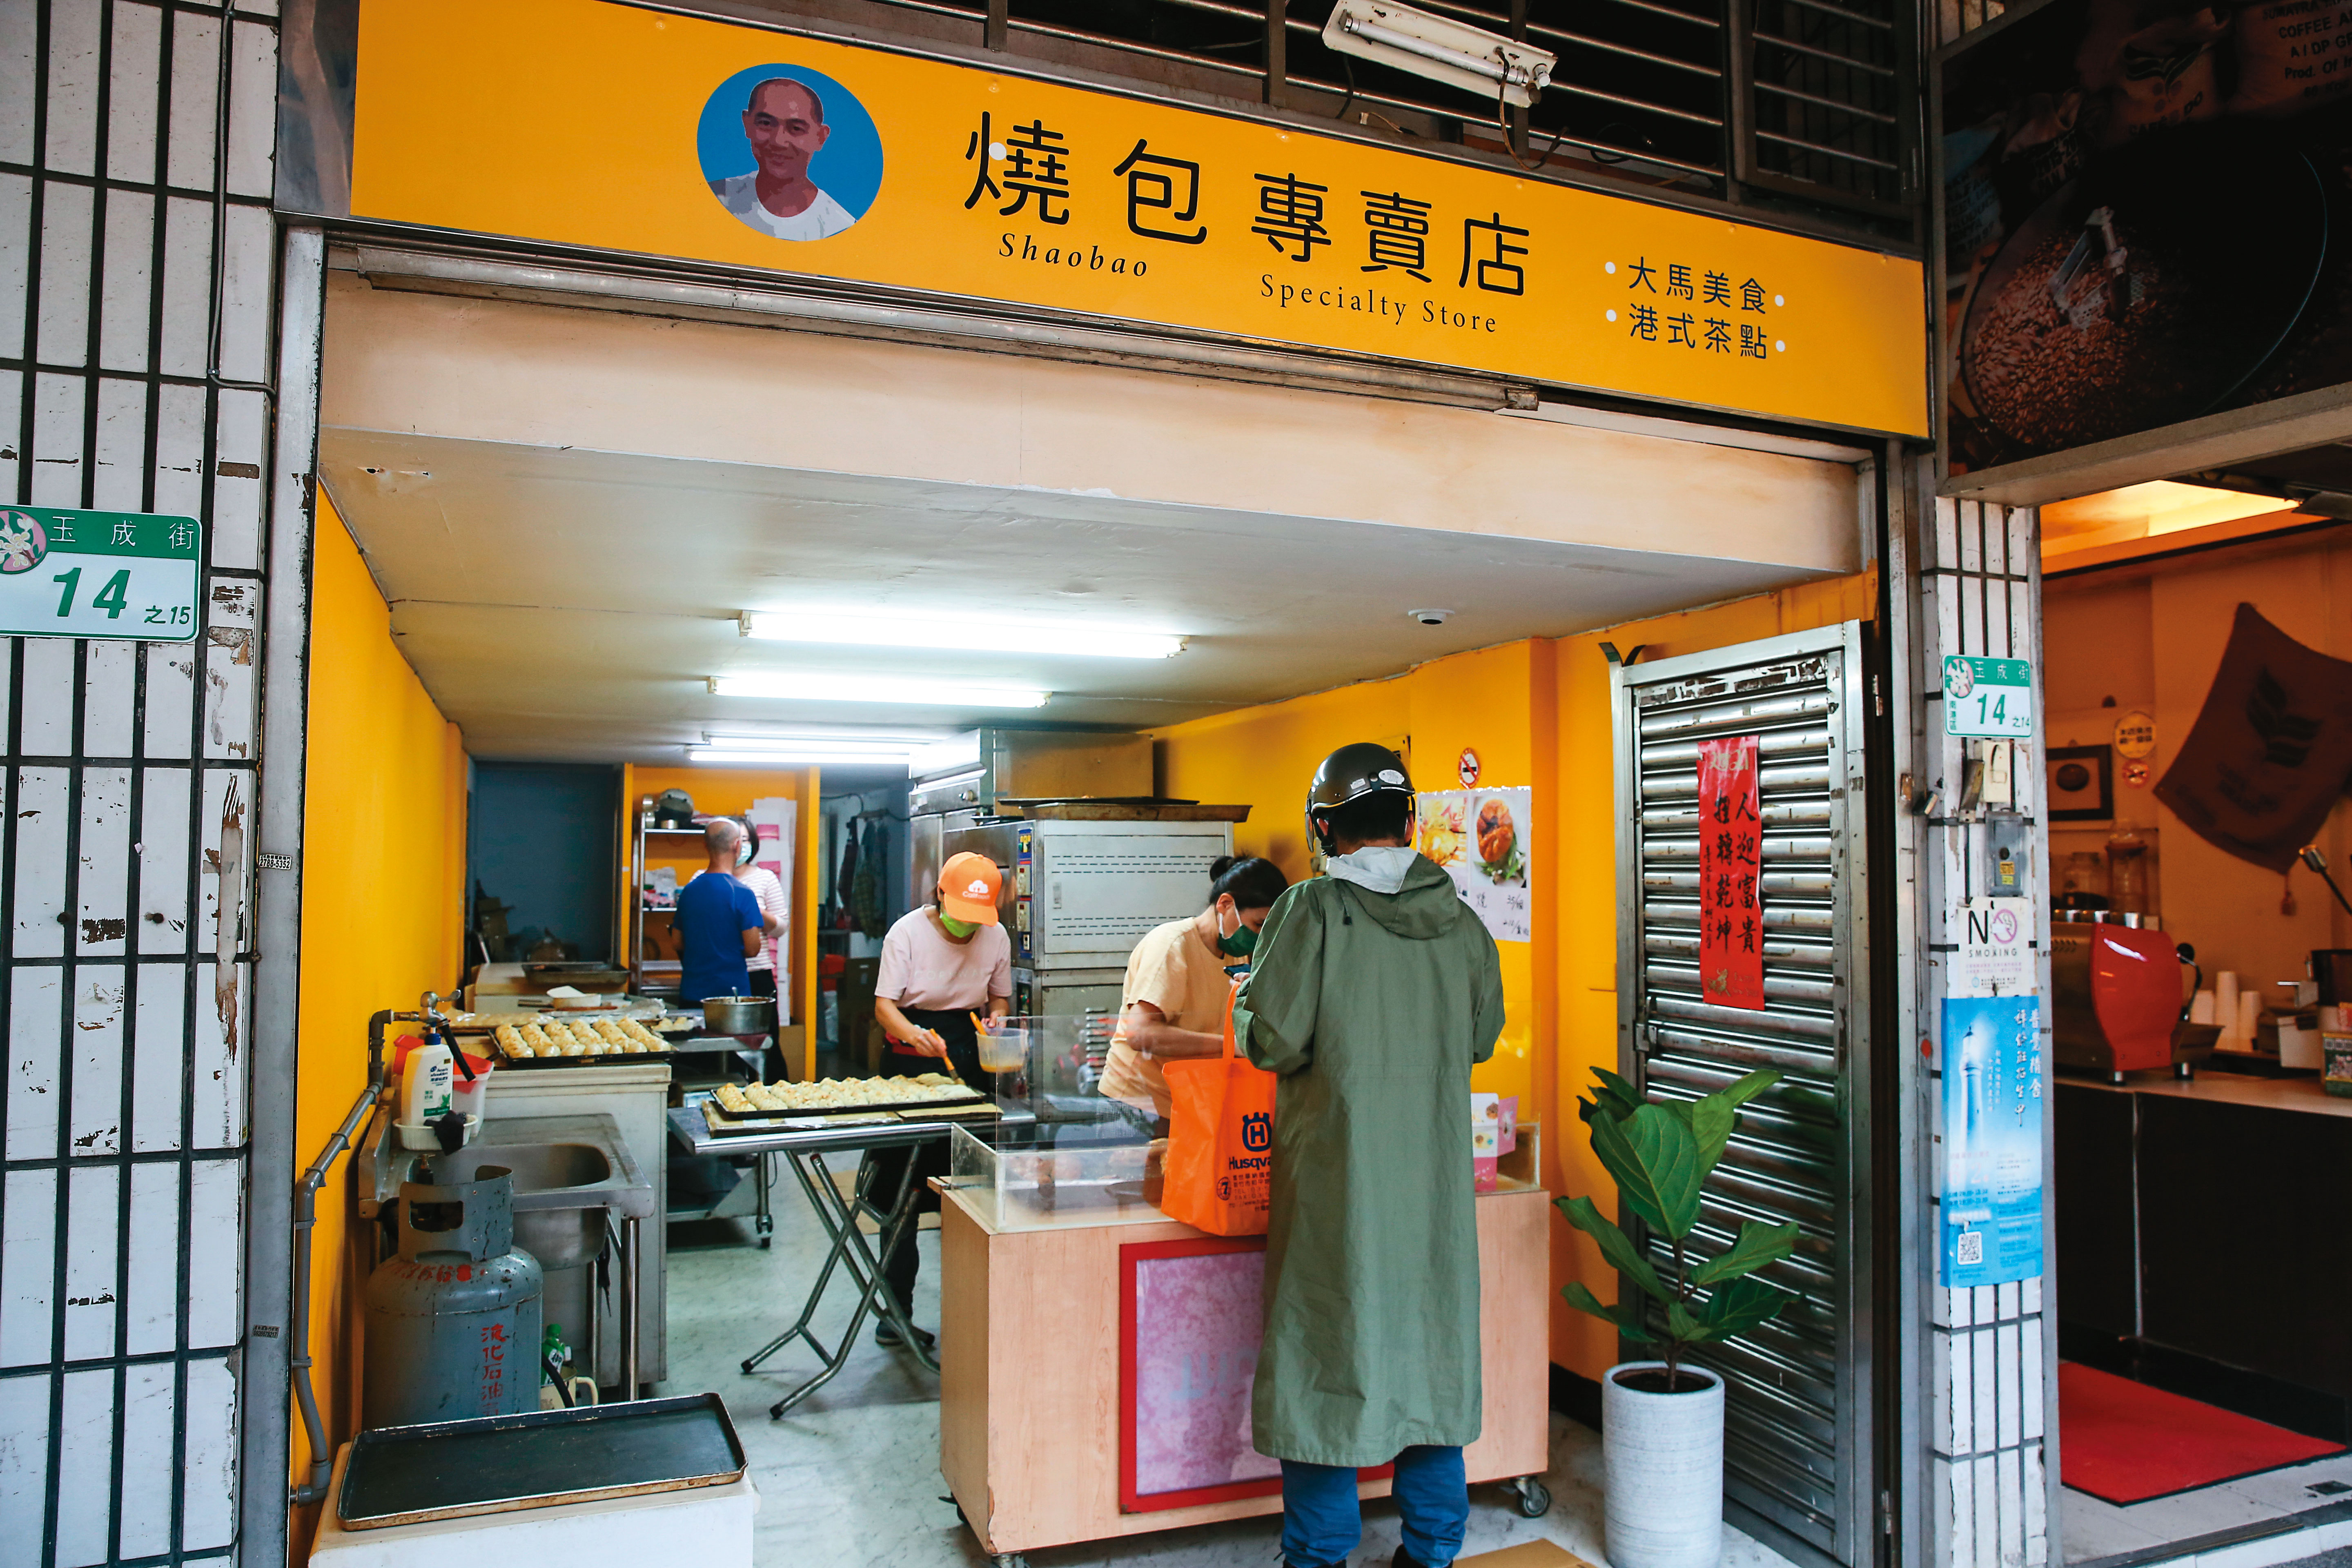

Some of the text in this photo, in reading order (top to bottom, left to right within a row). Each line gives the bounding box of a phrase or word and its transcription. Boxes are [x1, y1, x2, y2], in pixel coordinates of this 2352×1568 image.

[2278, 17, 2332, 39] COFFEE
[2291, 46, 2299, 58] A
[2311, 39, 2330, 55] DP
[2285, 65, 2316, 79] Prod.
[2323, 58, 2339, 74] Of
[964, 111, 1530, 296] 燒包專賣店
[999, 233, 1148, 276] Shaobao
[1261, 274, 1497, 333] Specialty Store
[1628, 256, 1766, 314] 大馬美食
[1628, 303, 1767, 359] 港式茶點
[50, 516, 194, 550] 玉成街
[53, 567, 191, 624] 14 之15
[1978, 693, 2005, 725] 14
[1736, 791, 1757, 954] 人迎富貴
